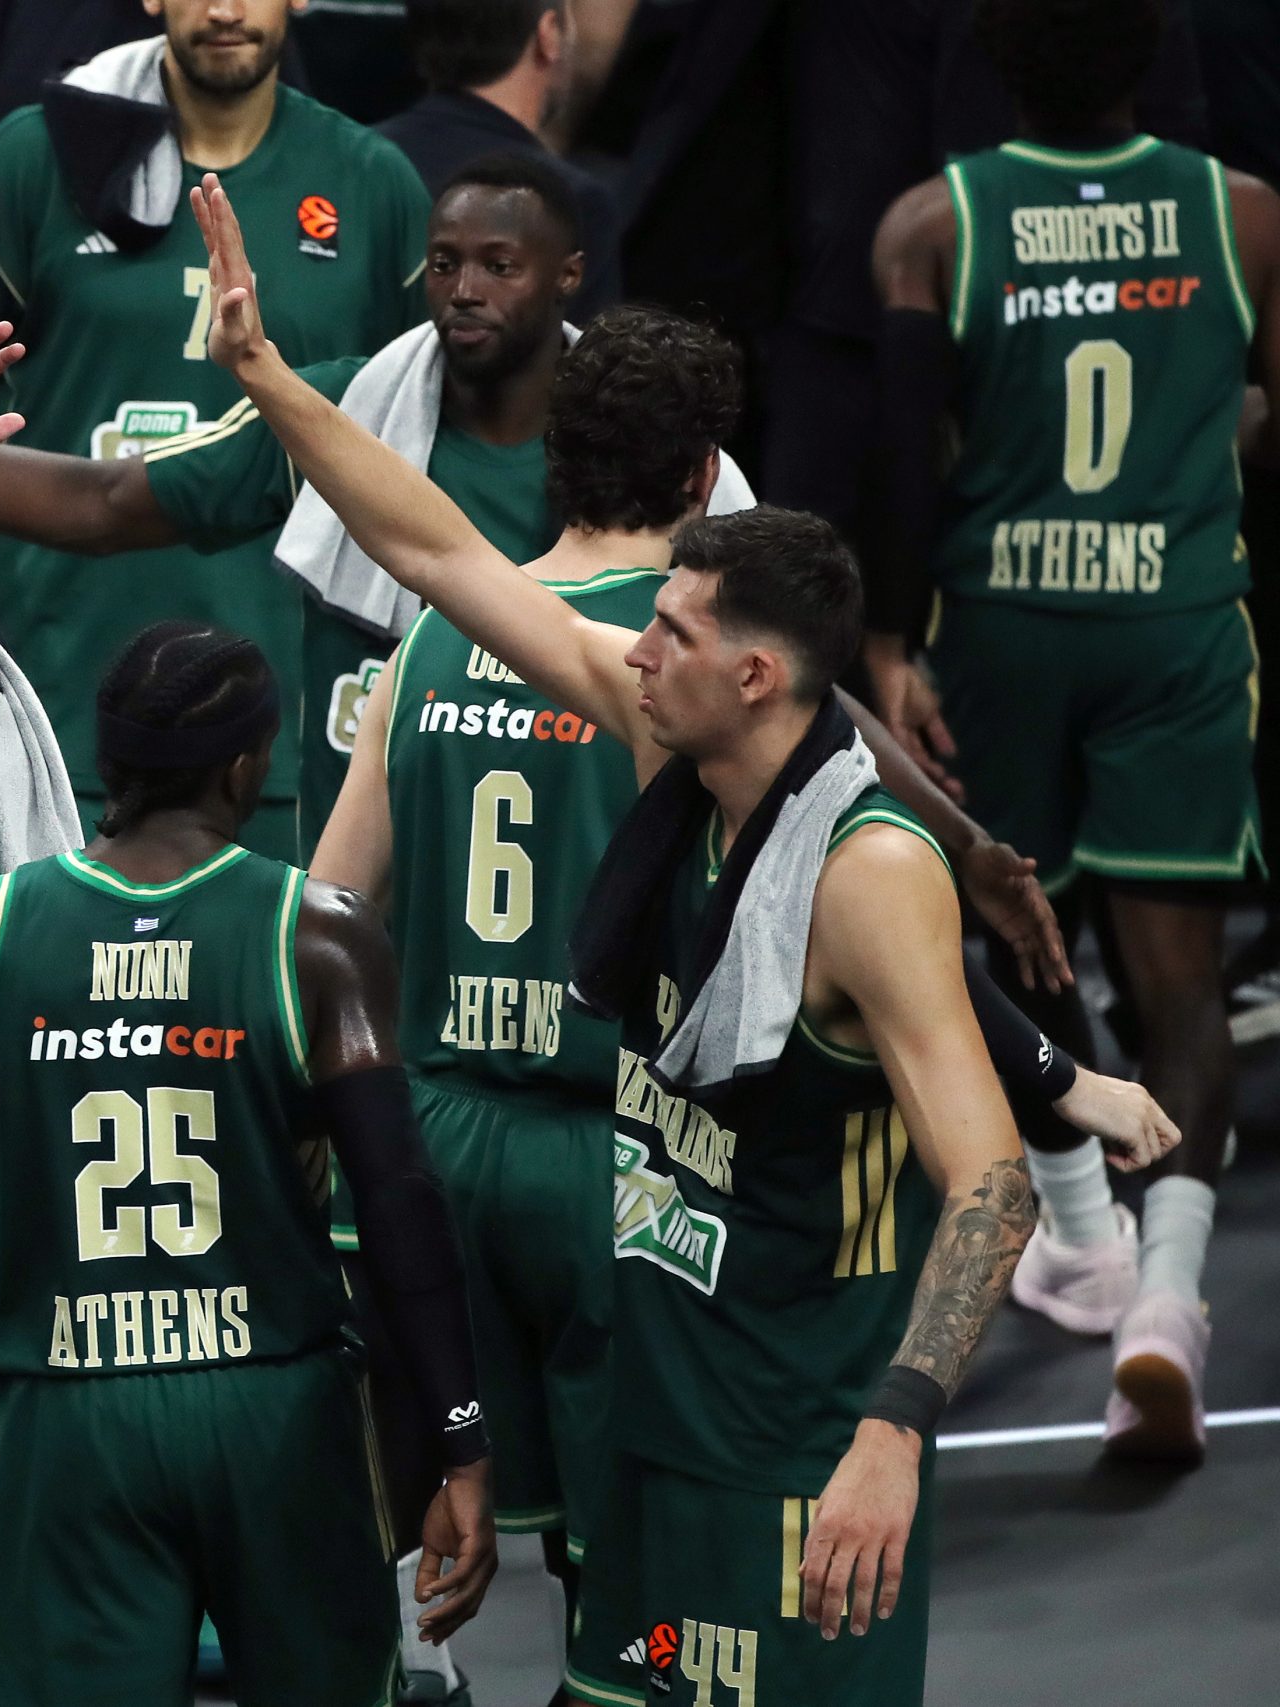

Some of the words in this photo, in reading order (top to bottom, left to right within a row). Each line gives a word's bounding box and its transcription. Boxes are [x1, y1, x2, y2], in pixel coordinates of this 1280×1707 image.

[1011, 202, 1145, 264] SHORTS
[1150, 199, 1180, 257] II
[1003, 276, 1200, 326] instacar
[1063, 338, 1132, 494] 0
[988, 519, 1166, 593] ATHENS
[465, 770, 533, 943] 6
[90, 939, 193, 1001] NUNN
[30, 1016, 246, 1061] instacar
[71, 1086, 223, 1262] 25
[48, 1285, 252, 1368] ATHENS
[680, 1617, 758, 1707] 44
